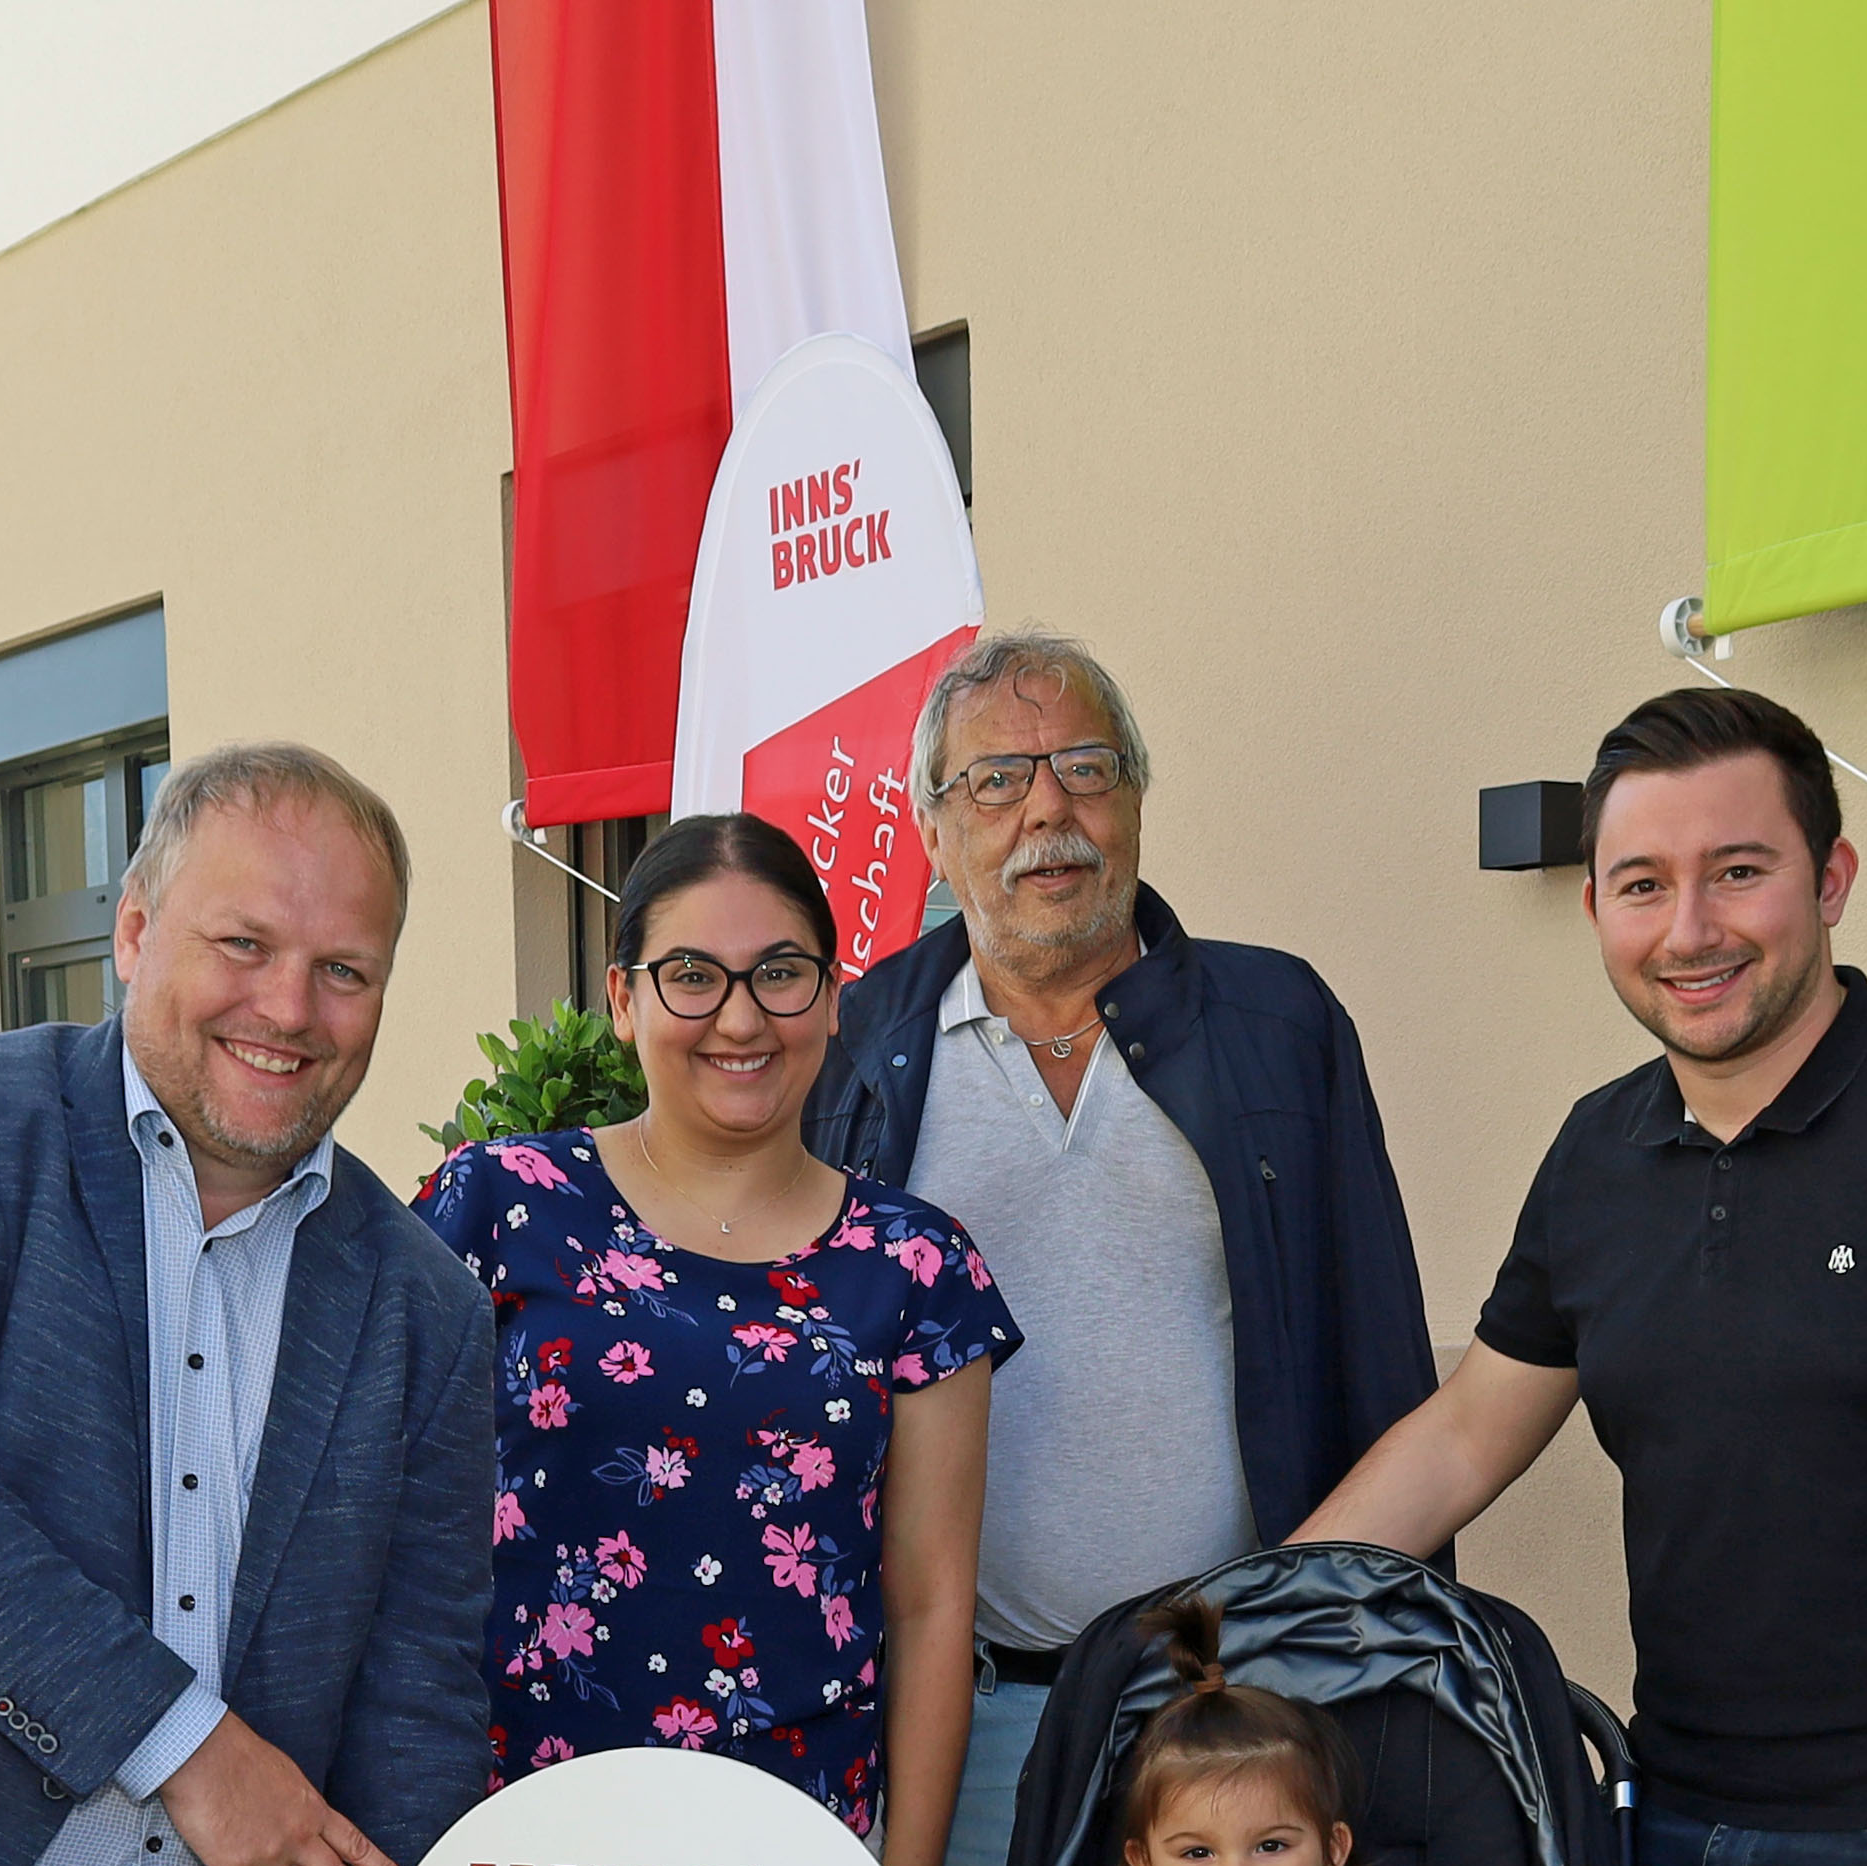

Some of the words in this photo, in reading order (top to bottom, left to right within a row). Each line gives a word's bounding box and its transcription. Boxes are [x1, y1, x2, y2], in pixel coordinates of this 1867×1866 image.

[769, 458, 861, 536] INNS'
[772, 509, 892, 591] BRUCK
[807, 736, 855, 896] cker
